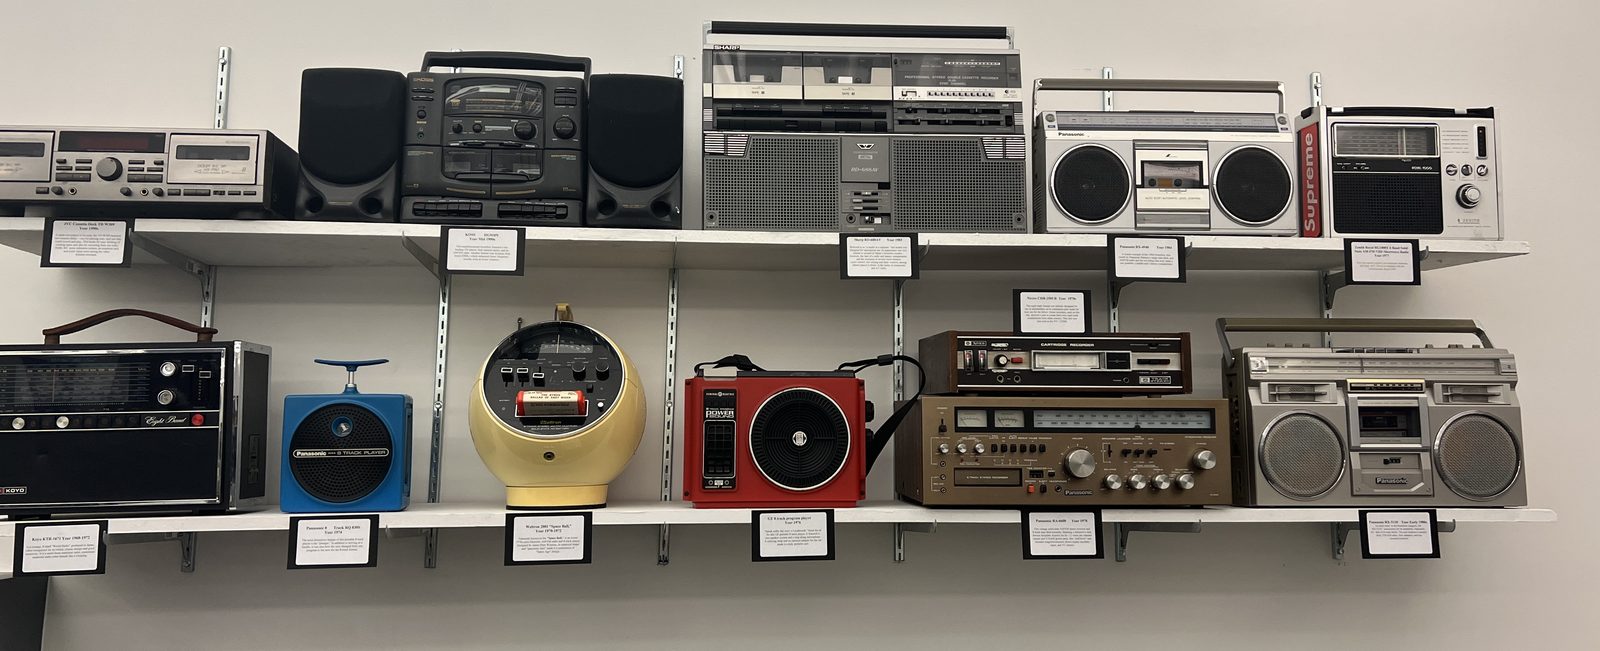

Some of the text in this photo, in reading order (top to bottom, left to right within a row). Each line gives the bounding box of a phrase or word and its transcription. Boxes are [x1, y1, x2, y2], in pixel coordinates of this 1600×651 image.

[1304, 133, 1318, 232] Supreme
[144, 415, 187, 426] Eight Band
[1376, 477, 1408, 485] Panasonic
